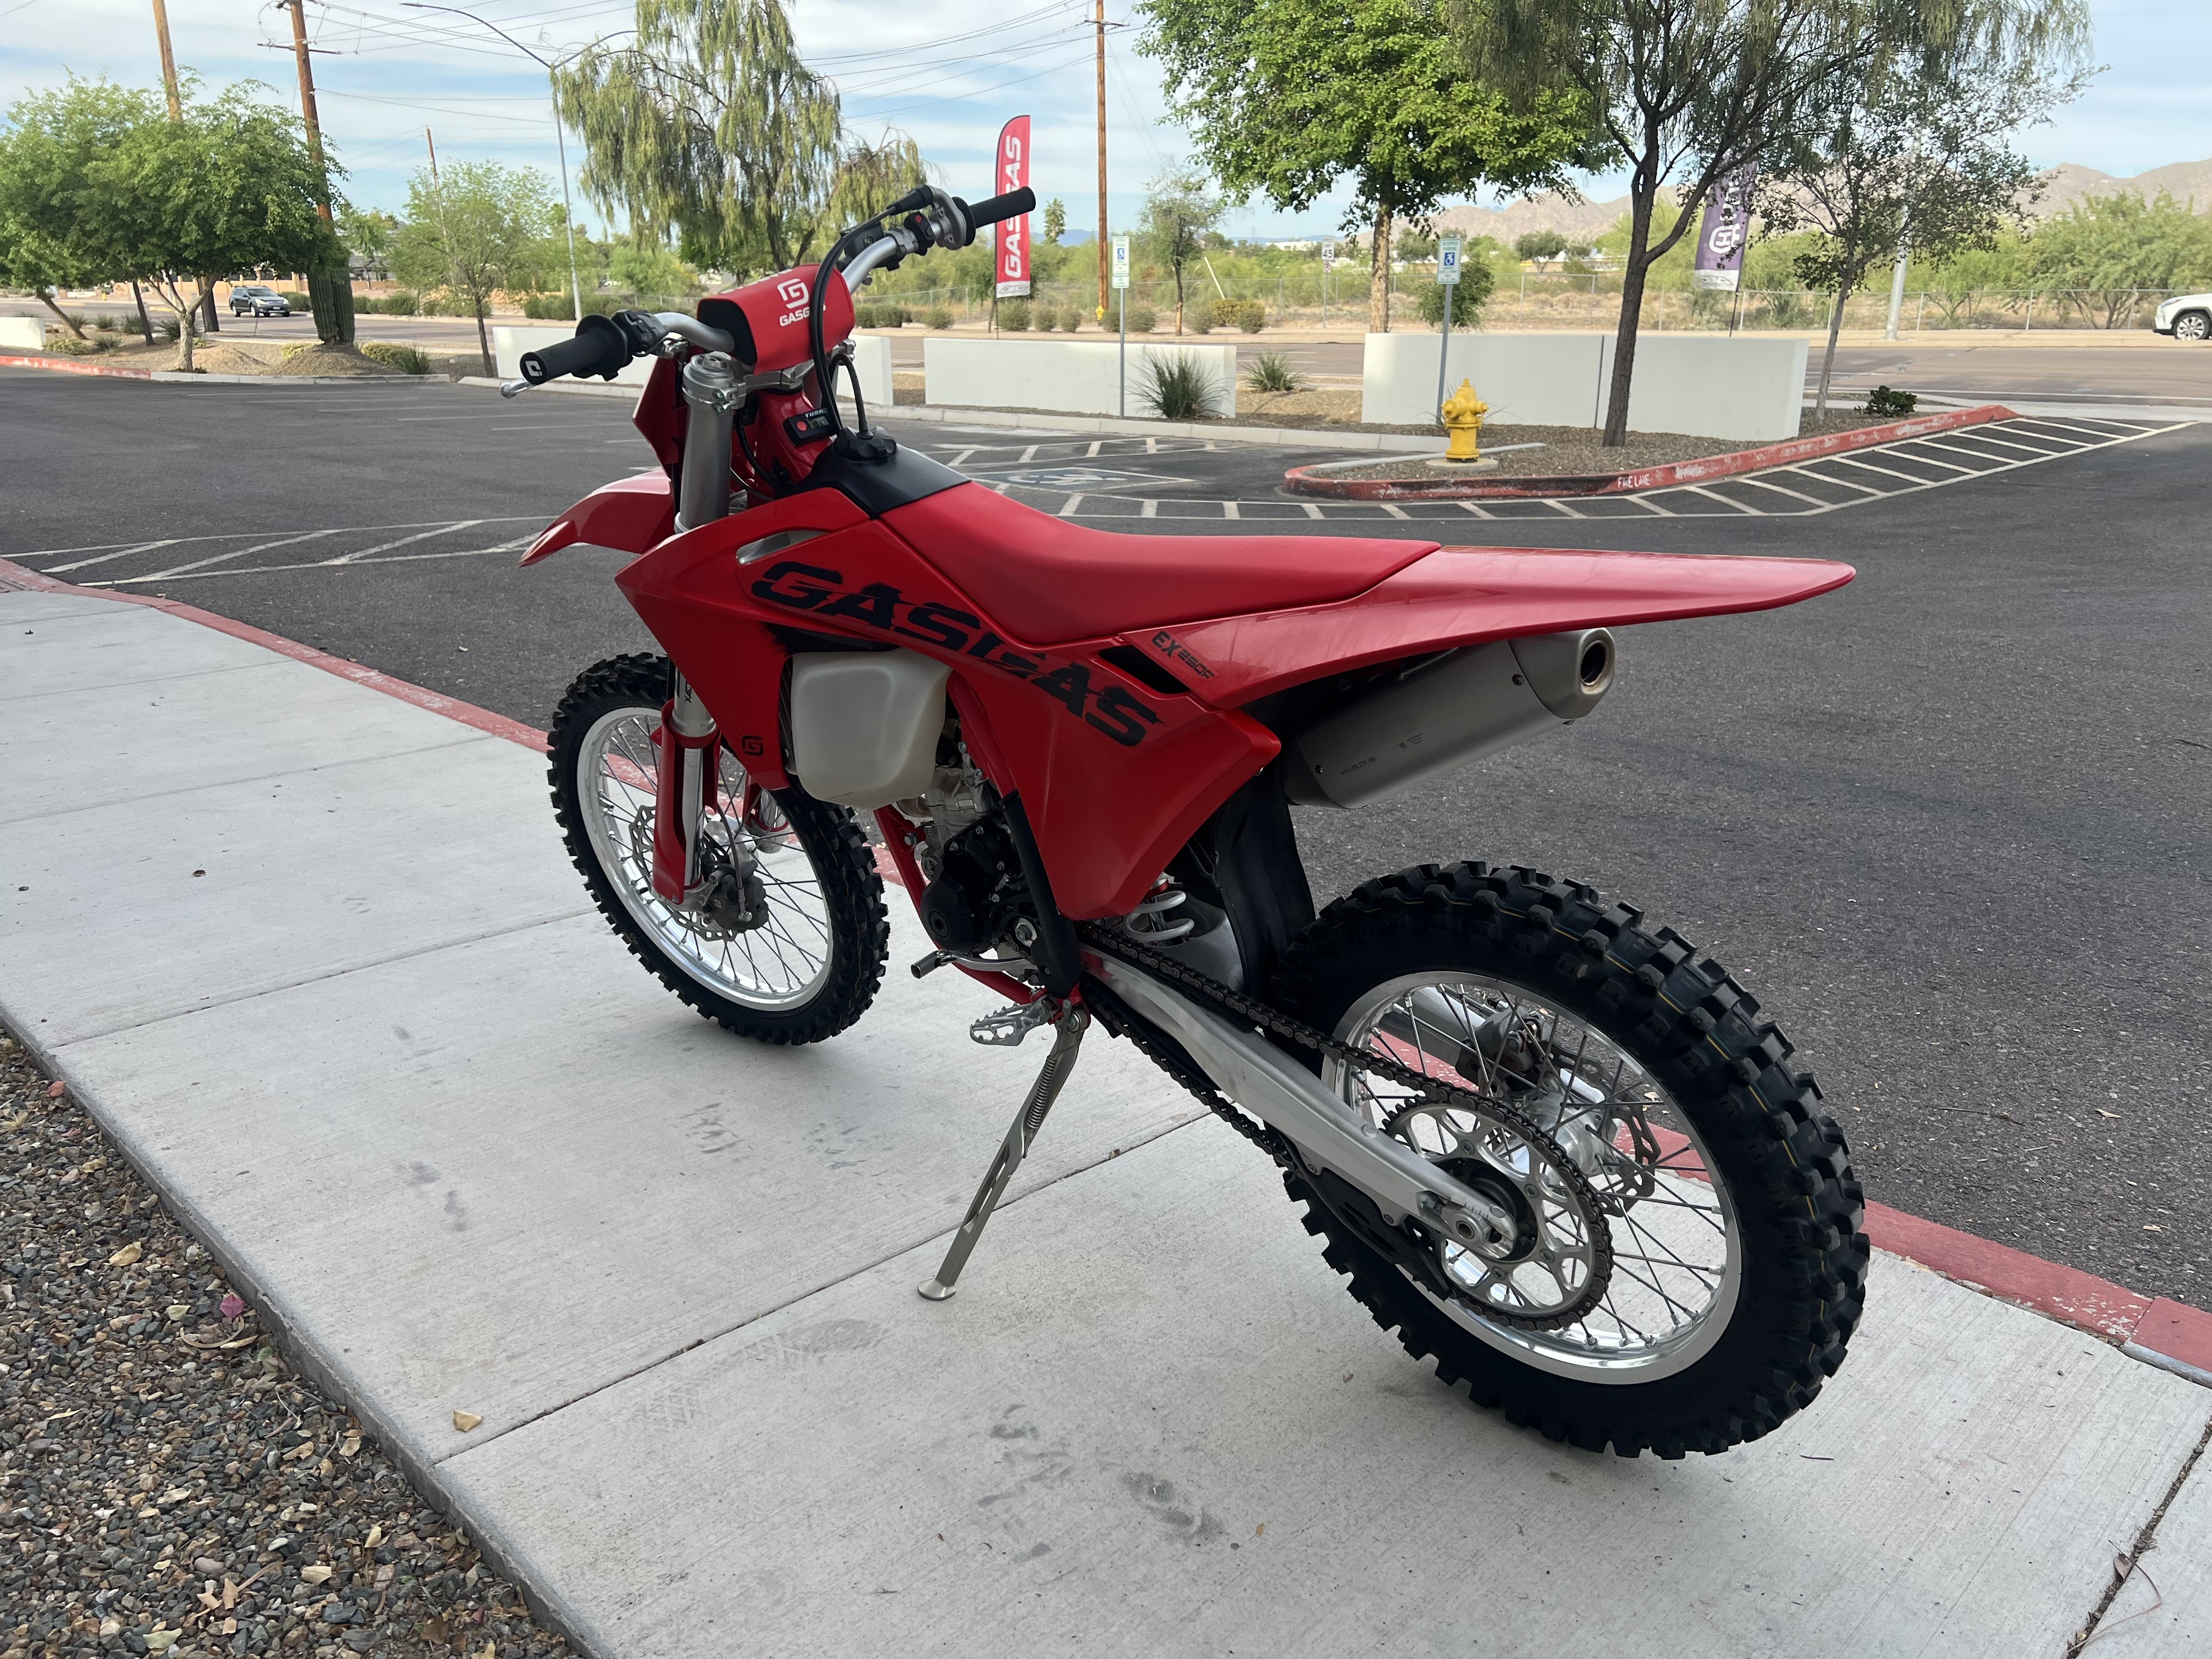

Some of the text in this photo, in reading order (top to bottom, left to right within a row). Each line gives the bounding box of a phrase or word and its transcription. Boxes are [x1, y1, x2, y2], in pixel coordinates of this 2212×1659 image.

[780, 301, 826, 327] GASG
[1152, 630, 1215, 679] EX 250F
